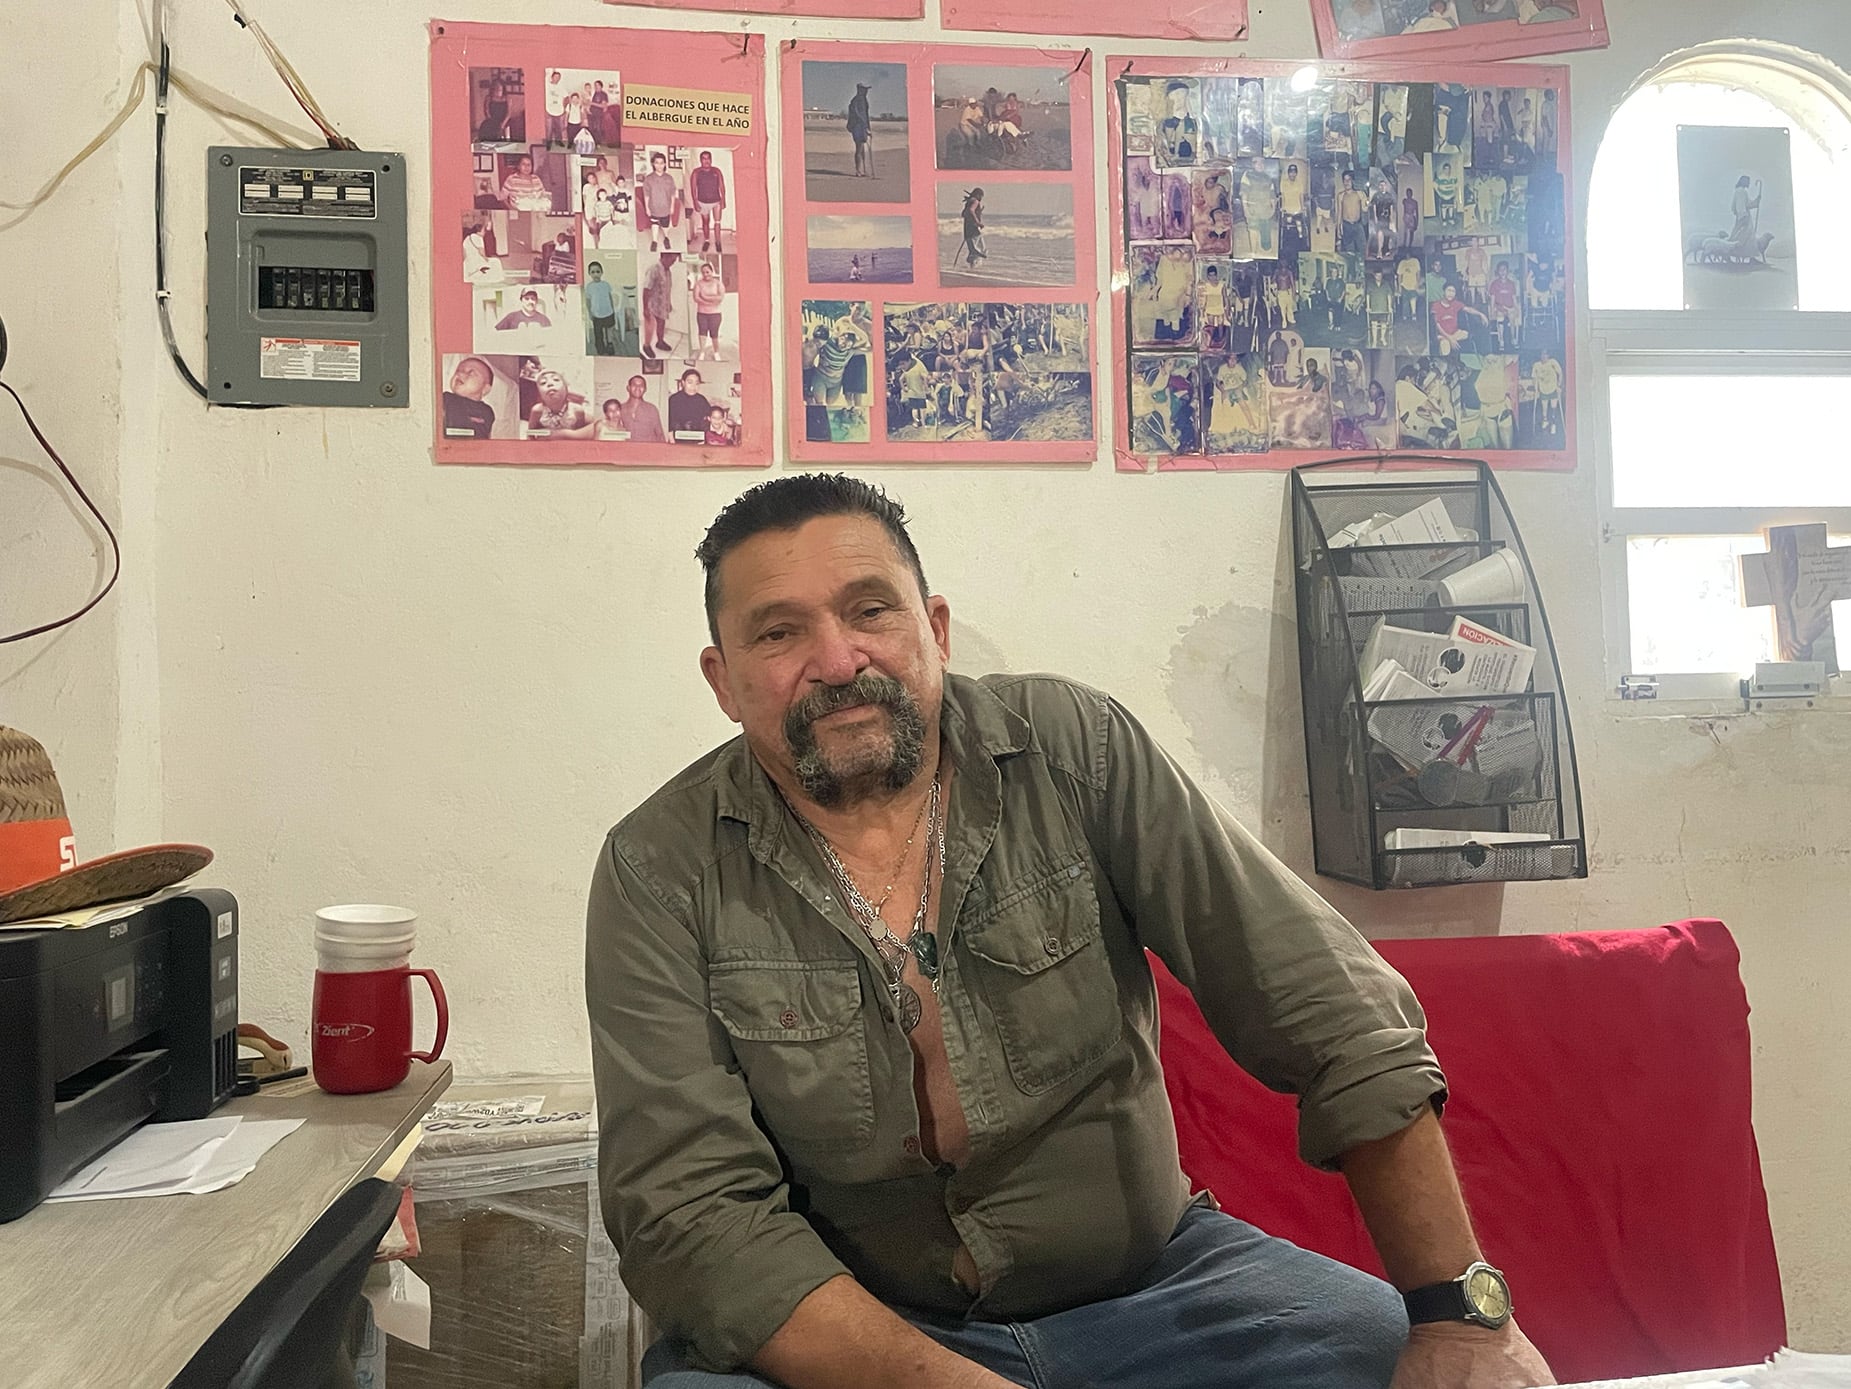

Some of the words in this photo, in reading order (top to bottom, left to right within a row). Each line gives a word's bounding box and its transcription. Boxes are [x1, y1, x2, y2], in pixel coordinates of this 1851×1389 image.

[626, 95, 695, 109] DONACIONES
[697, 101, 720, 112] QUE
[722, 104, 750, 115] HACE
[625, 110, 637, 119] EL
[639, 112, 693, 124] ALBERGUE
[696, 116, 710, 126] EN
[712, 117, 724, 127] EL
[726, 117, 750, 129] AÑO
[110, 922, 128, 938] EPSON
